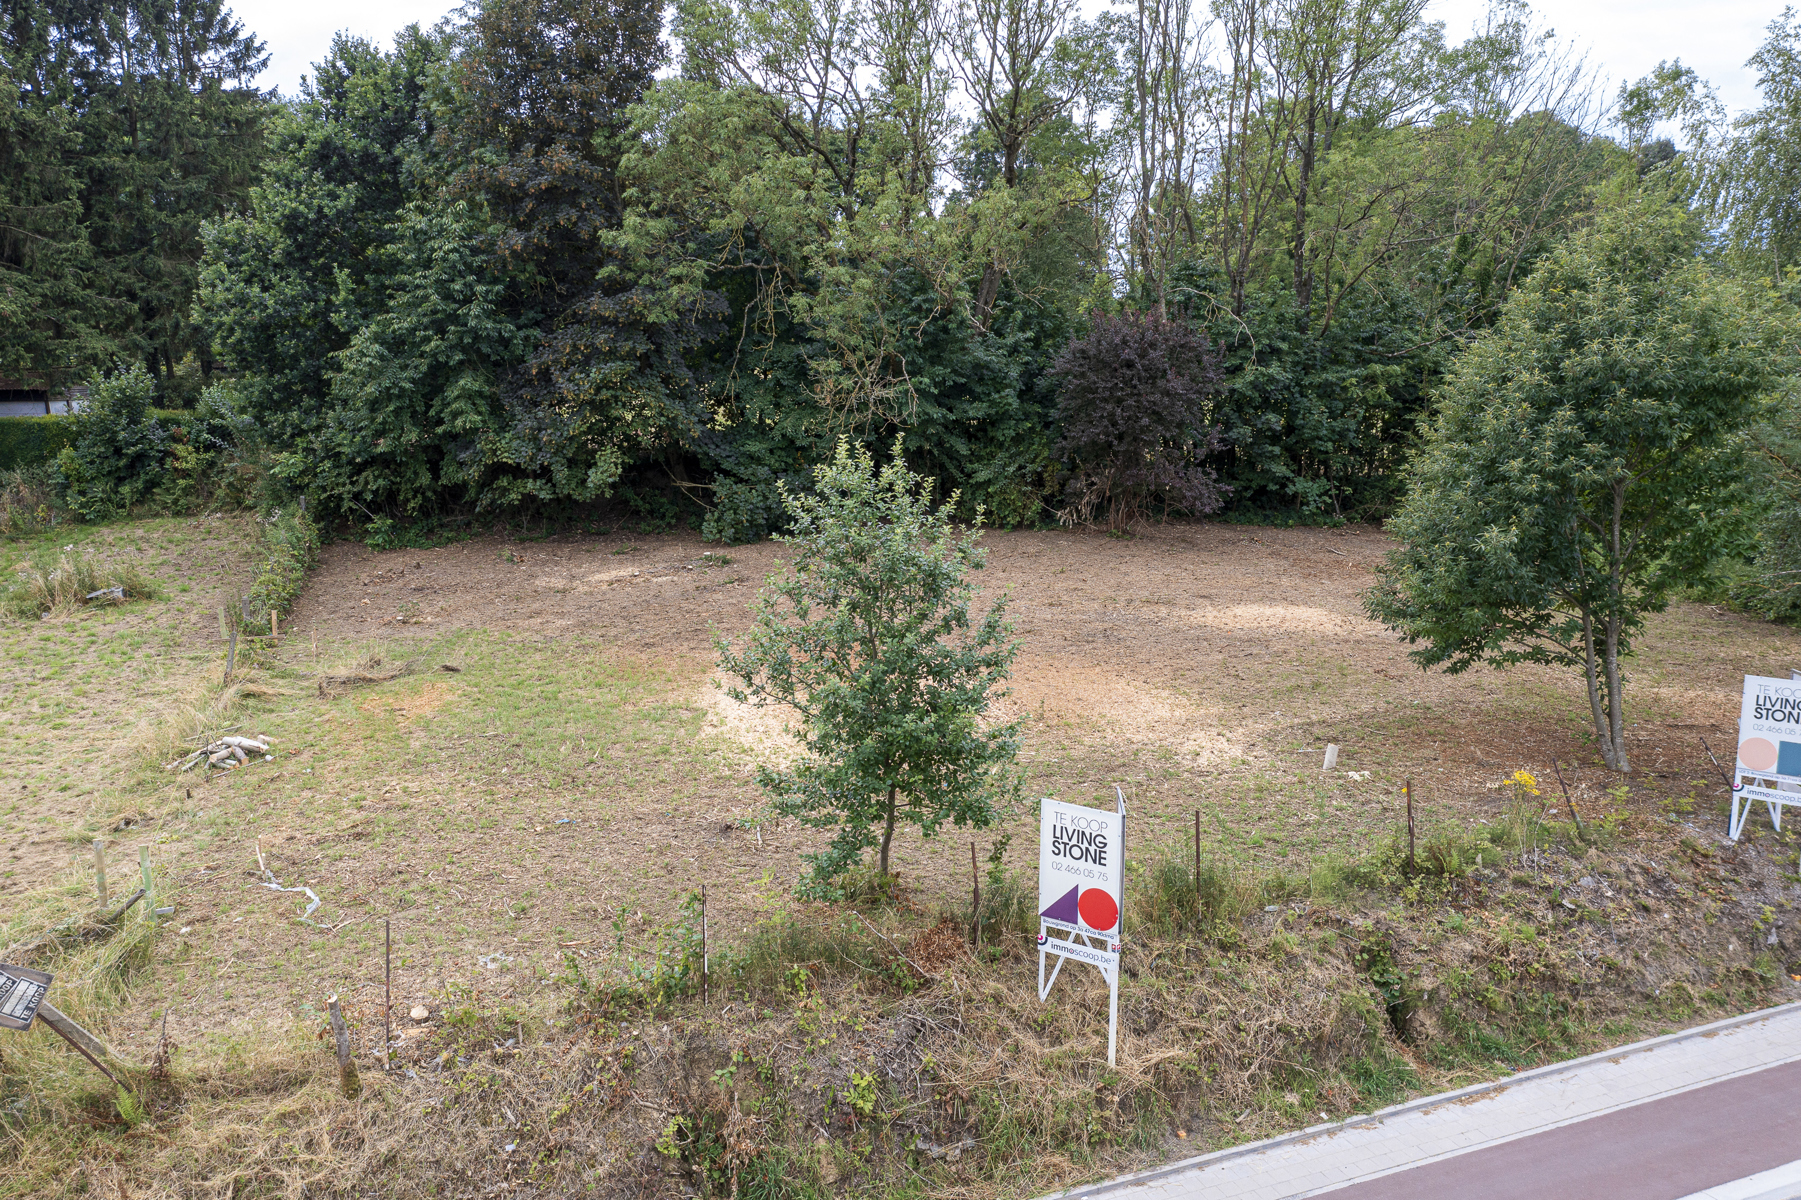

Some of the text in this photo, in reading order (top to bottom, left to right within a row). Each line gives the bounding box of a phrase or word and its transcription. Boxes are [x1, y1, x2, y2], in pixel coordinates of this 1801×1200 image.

[1757, 684, 1771, 695] TE
[1753, 706, 1801, 725] STON
[1752, 723, 1764, 732] 02
[1766, 725, 1783, 734] 466
[1784, 727, 1796, 736] 05
[1054, 811, 1108, 833] TE KOOP
[1053, 824, 1108, 849] LIVING
[1051, 840, 1107, 867] STONE
[1051, 861, 1109, 882] 02 466 05 75
[1050, 941, 1112, 965] immoscoop.be
[0, 979, 13, 1000] OOP
[20, 1009, 32, 1019] TE
